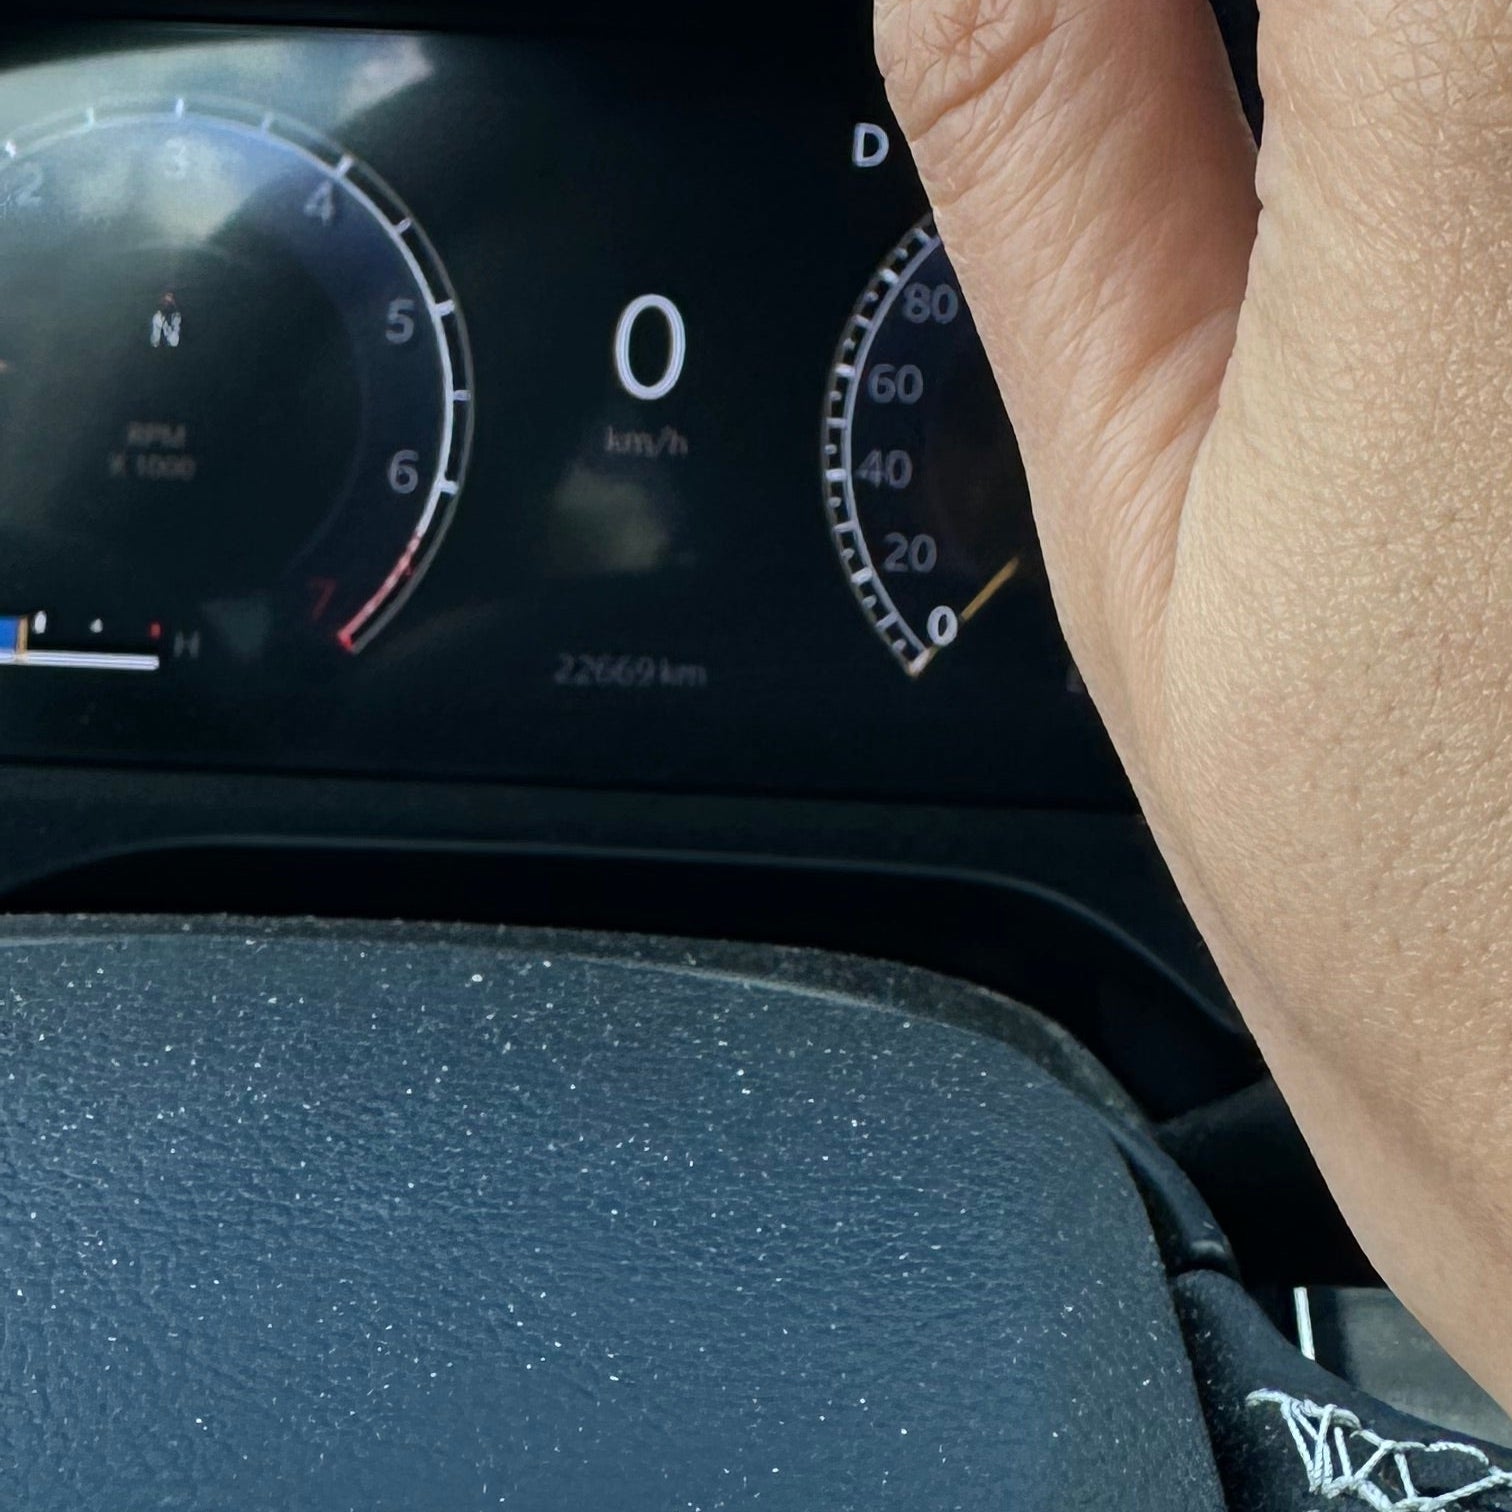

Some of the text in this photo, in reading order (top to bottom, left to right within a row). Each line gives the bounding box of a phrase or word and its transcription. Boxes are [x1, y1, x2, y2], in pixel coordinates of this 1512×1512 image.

[164, 138, 188, 178] 3
[851, 121, 890, 168] D
[304, 180, 336, 224] 4
[384, 299, 415, 345] 5
[901, 282, 959, 325] 80
[151, 310, 181, 348] N
[613, 292, 687, 401] 0
[868, 362, 925, 405] 60
[603, 424, 689, 459] km/h
[387, 449, 420, 495] 6
[857, 448, 913, 490] 40
[883, 533, 938, 574] 20
[309, 576, 338, 622] 7
[173, 629, 201, 659] H
[926, 605, 959, 648] 0
